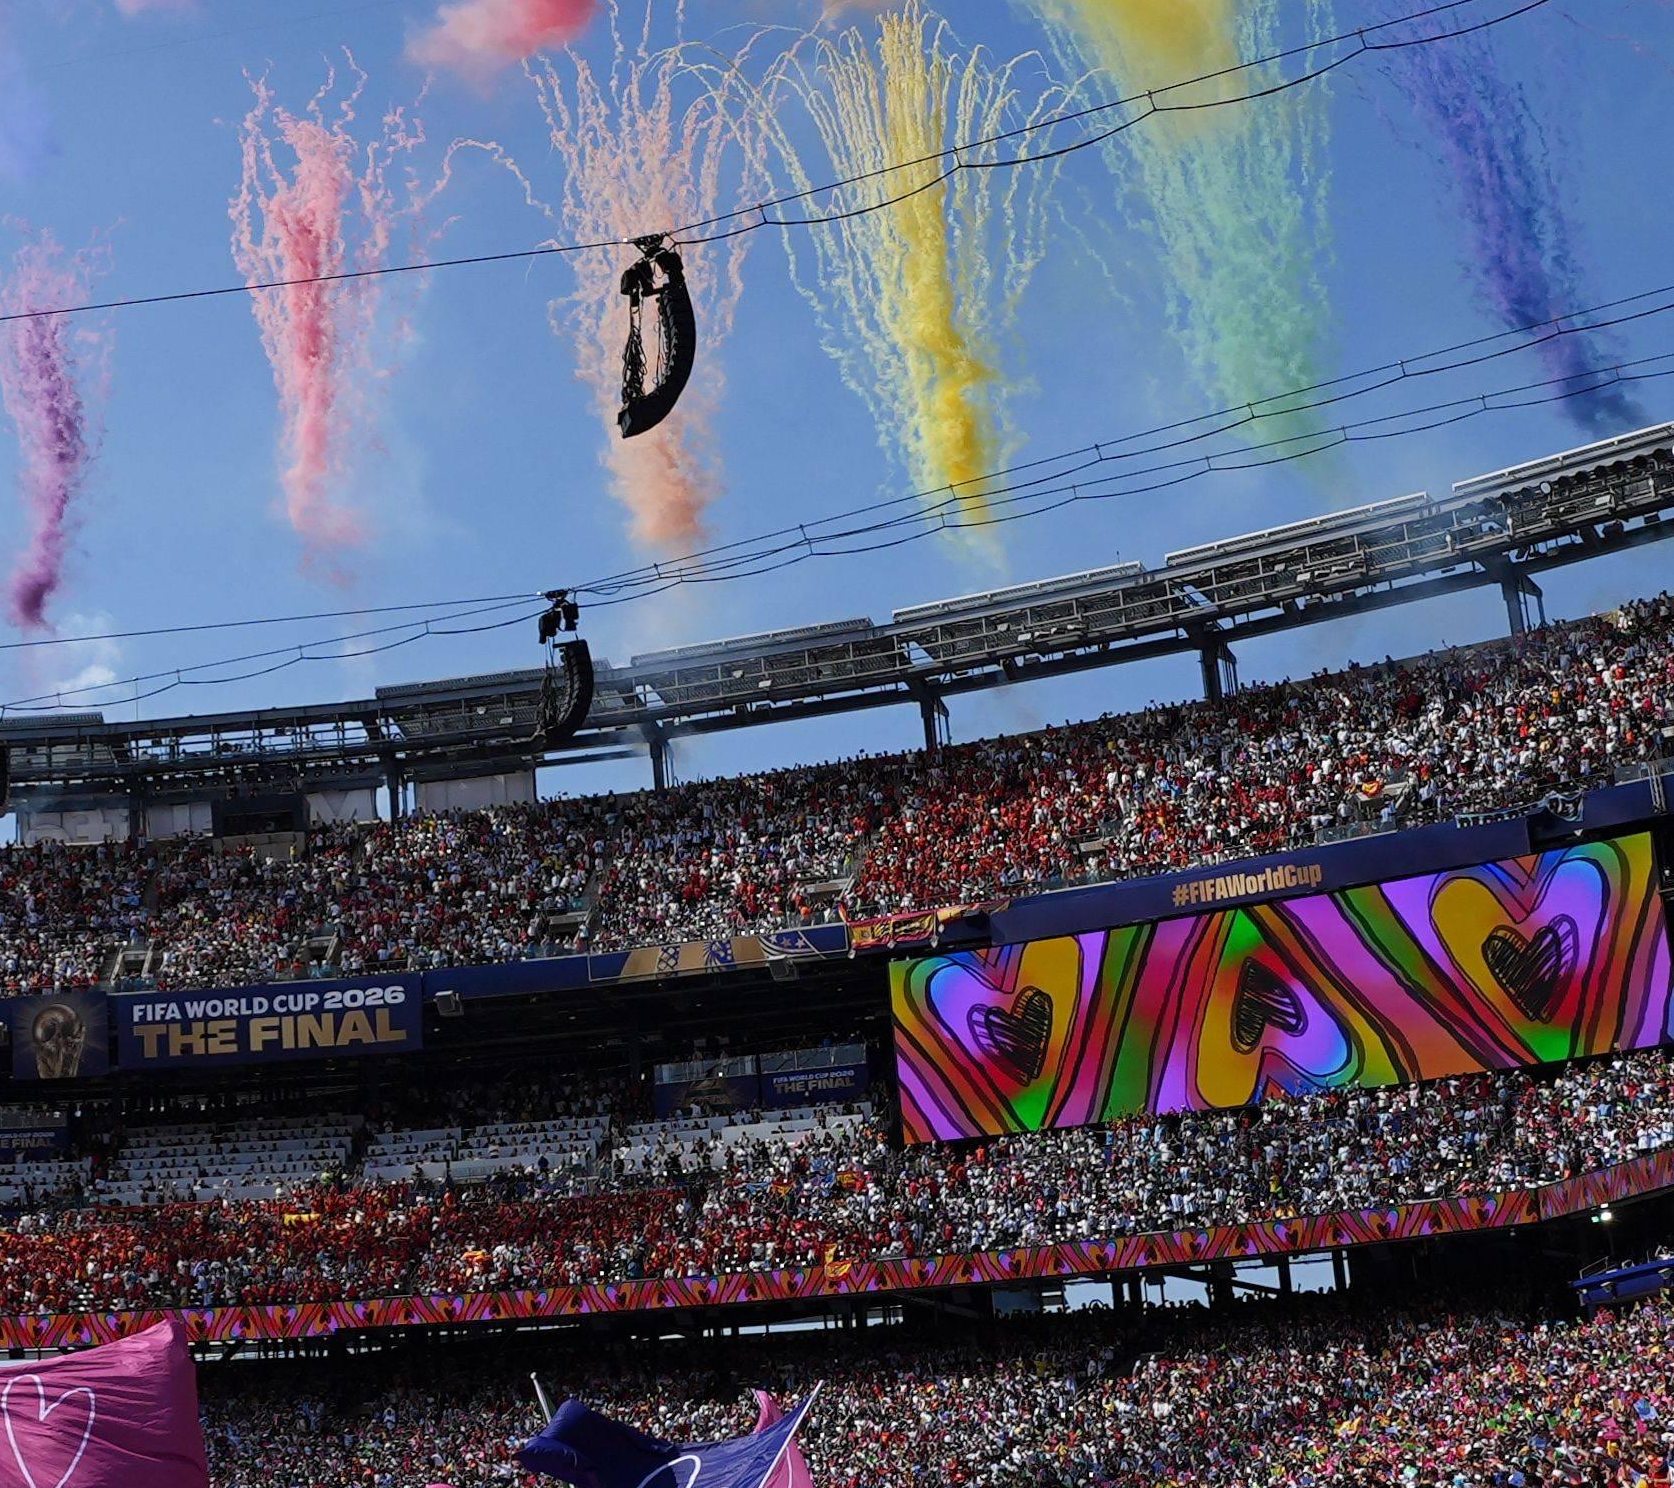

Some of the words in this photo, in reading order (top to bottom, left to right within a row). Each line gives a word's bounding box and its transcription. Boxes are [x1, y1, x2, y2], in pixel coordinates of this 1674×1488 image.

[1173, 864, 1323, 906] #FIFAWorldCup
[133, 1002, 180, 1023] FIFA
[185, 996, 268, 1019] WORLD
[273, 992, 319, 1013] CUP
[323, 985, 406, 1009] 2026
[134, 1020, 238, 1058] THE
[249, 1009, 407, 1052] FINAL
